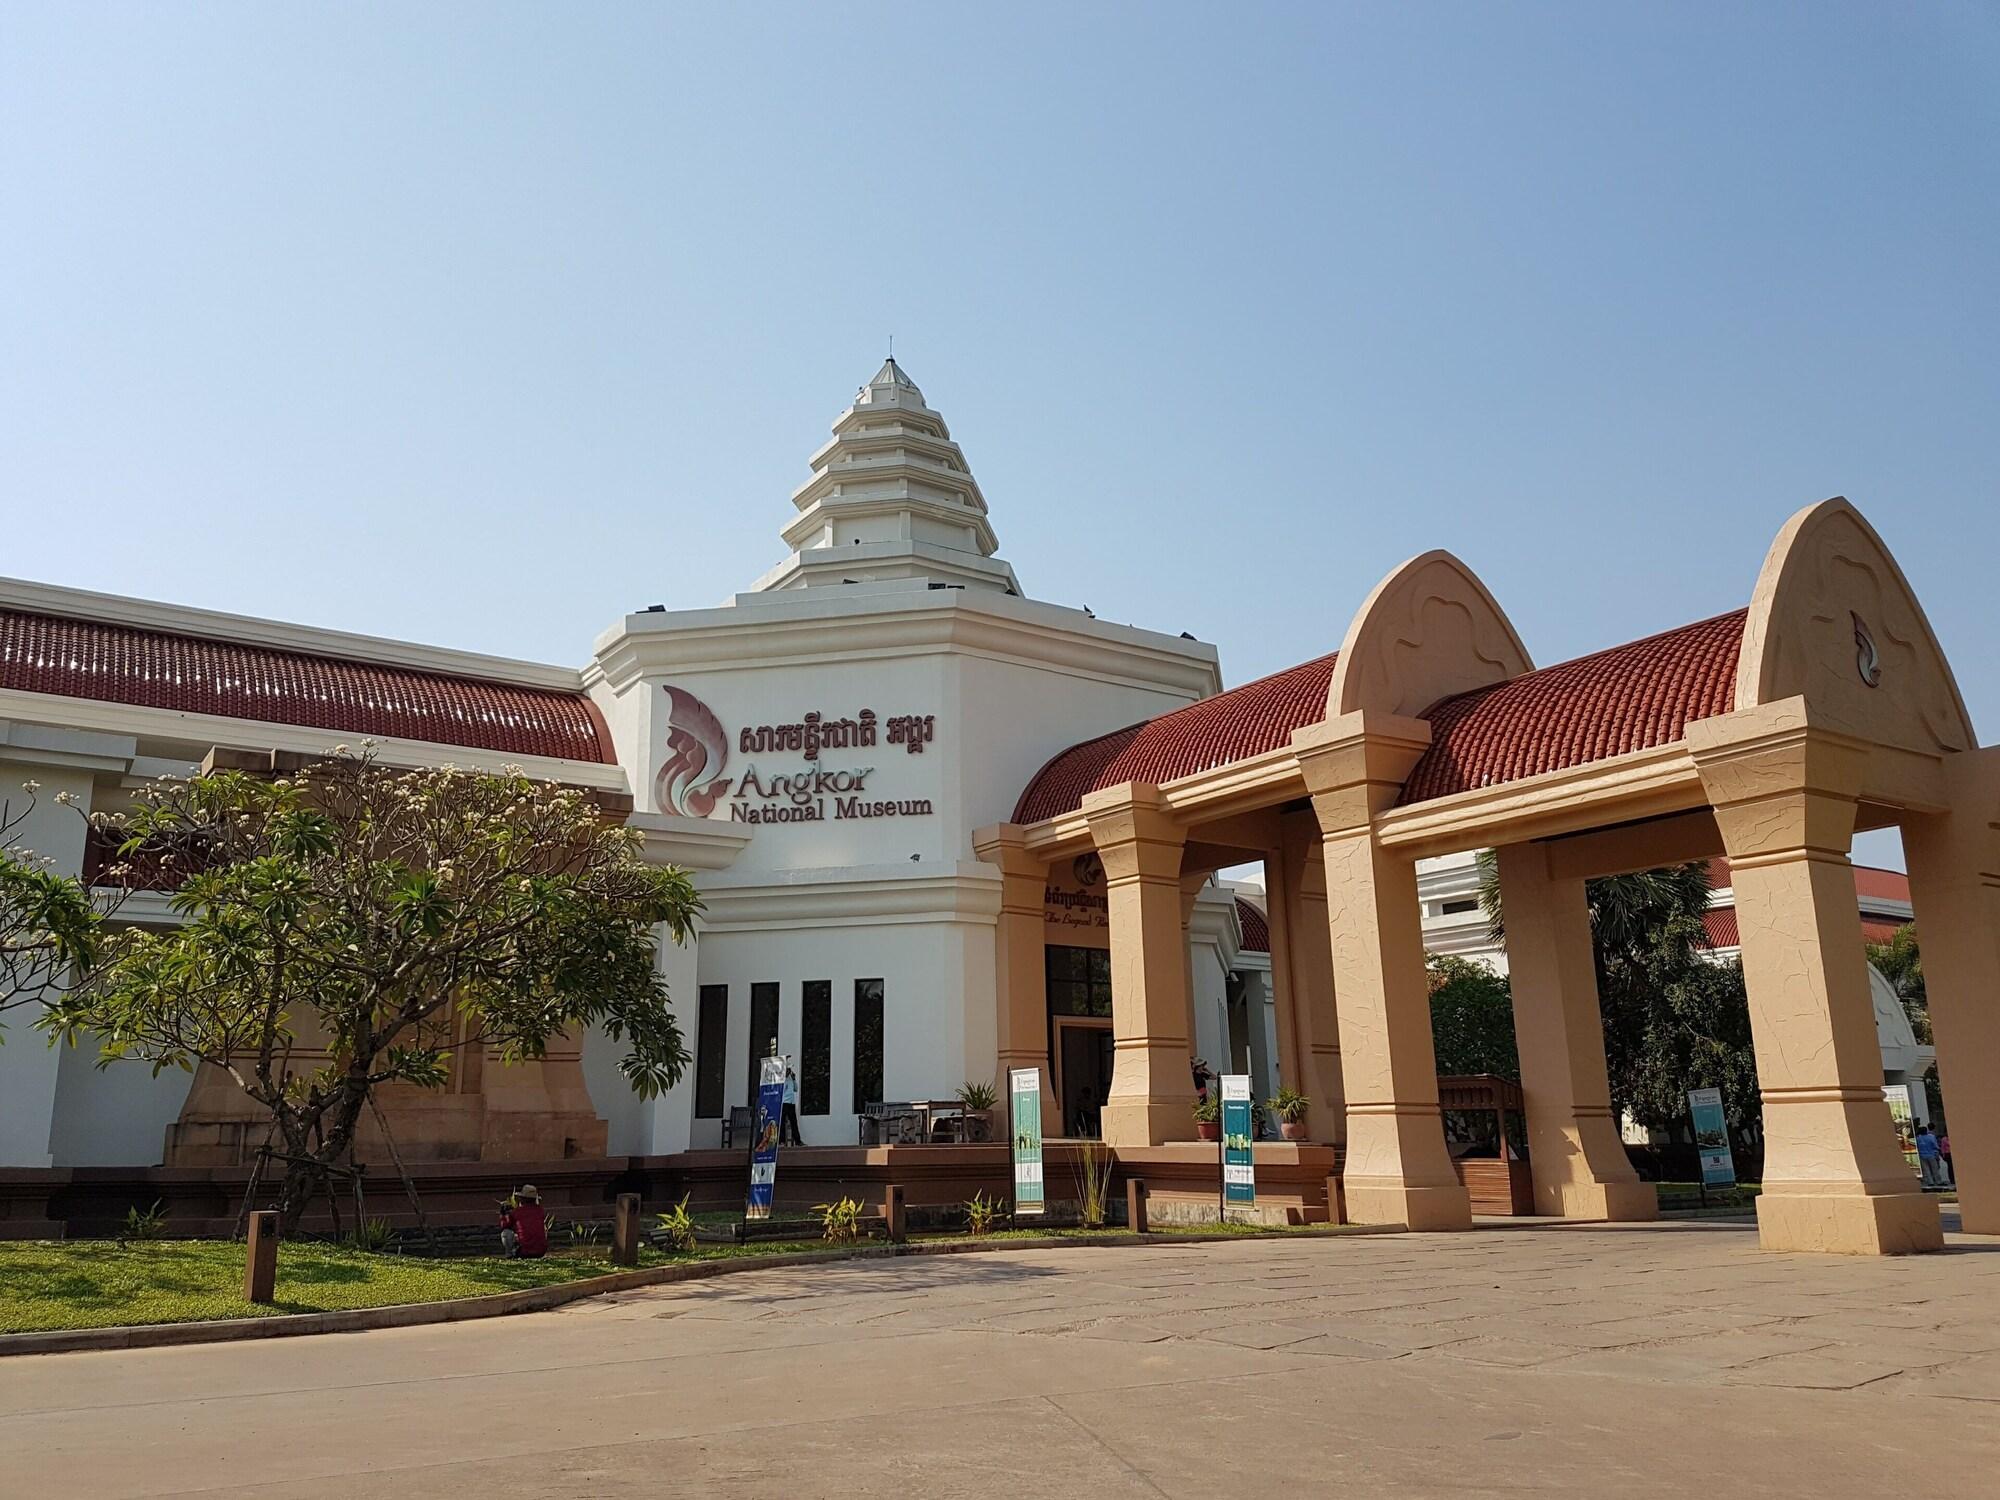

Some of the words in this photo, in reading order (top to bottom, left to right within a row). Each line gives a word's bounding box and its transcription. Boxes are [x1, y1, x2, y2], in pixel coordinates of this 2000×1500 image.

[886, 715, 935, 753] អង្គរ
[733, 760, 874, 805] Angkor
[730, 799, 824, 824] National
[834, 797, 932, 819] Museum
